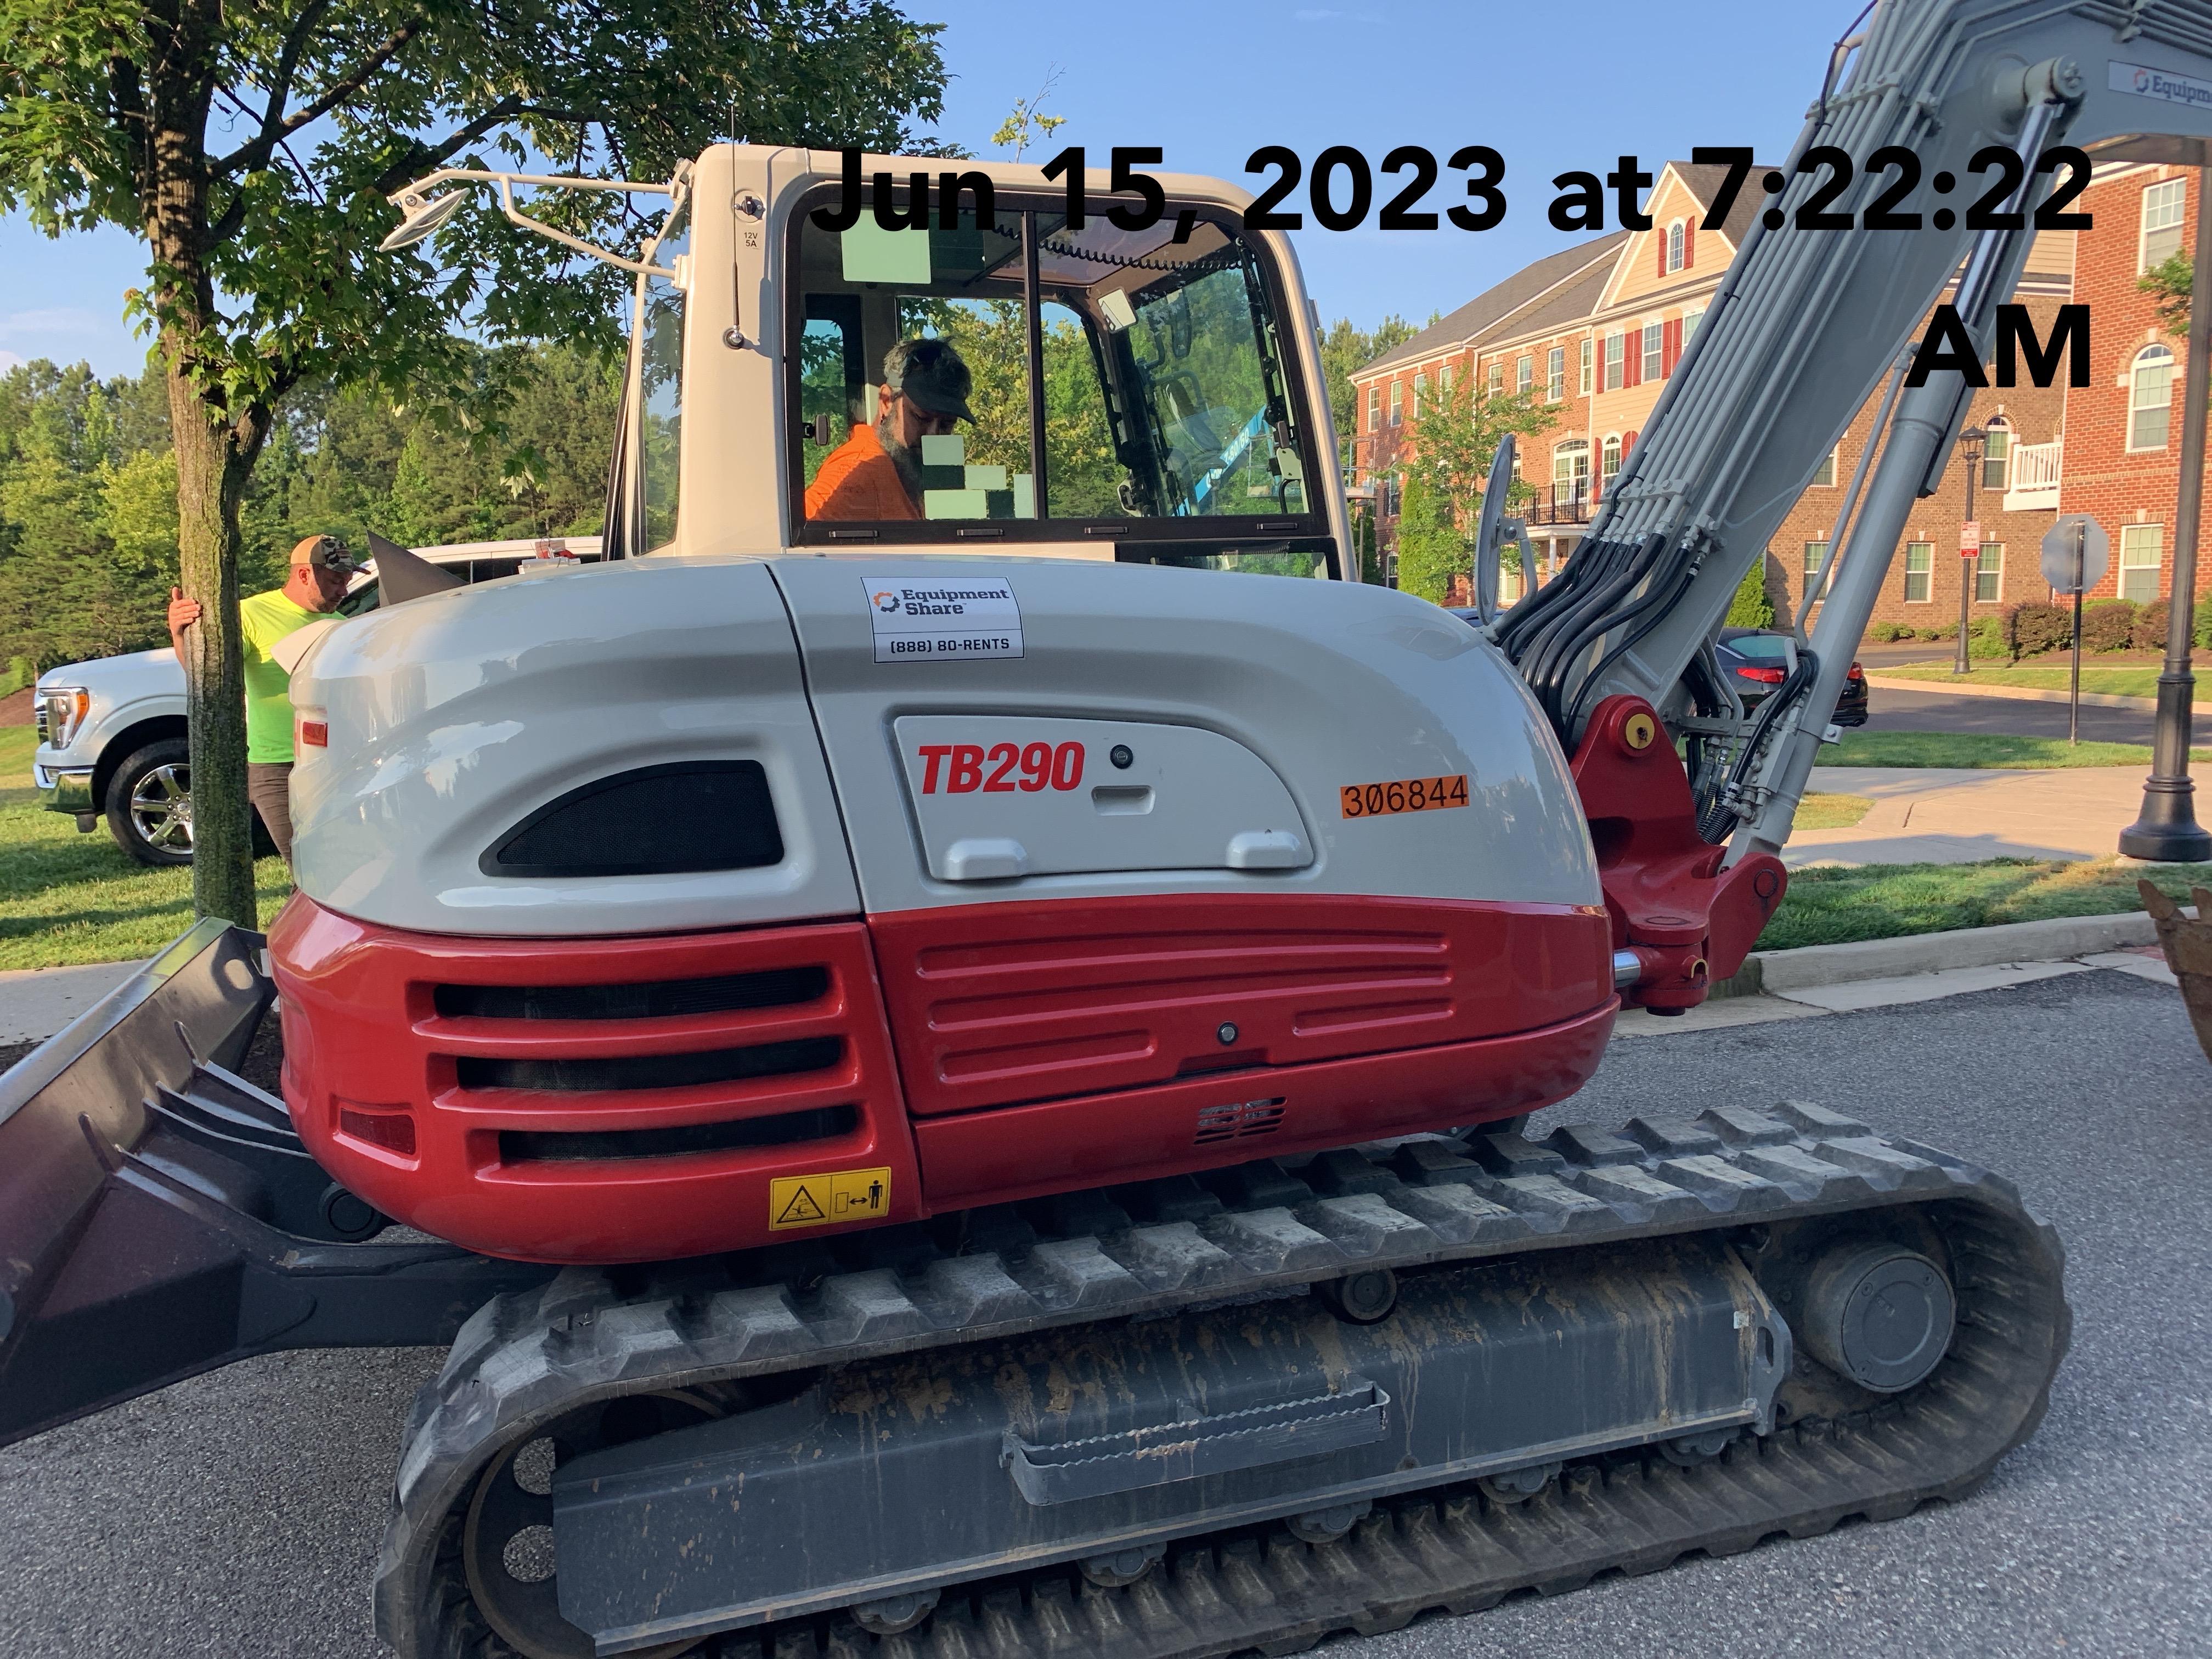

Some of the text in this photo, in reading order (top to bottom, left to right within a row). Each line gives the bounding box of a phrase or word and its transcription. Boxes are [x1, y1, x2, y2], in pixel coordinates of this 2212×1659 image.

[2152, 75, 2212, 103] Equipm
[901, 589, 1009, 602] Equipment
[905, 603, 964, 615] Share
[891, 638, 1009, 653] (888) 80-RENTS
[918, 742, 1085, 794] TB290
[1345, 775, 1468, 816] 306844
